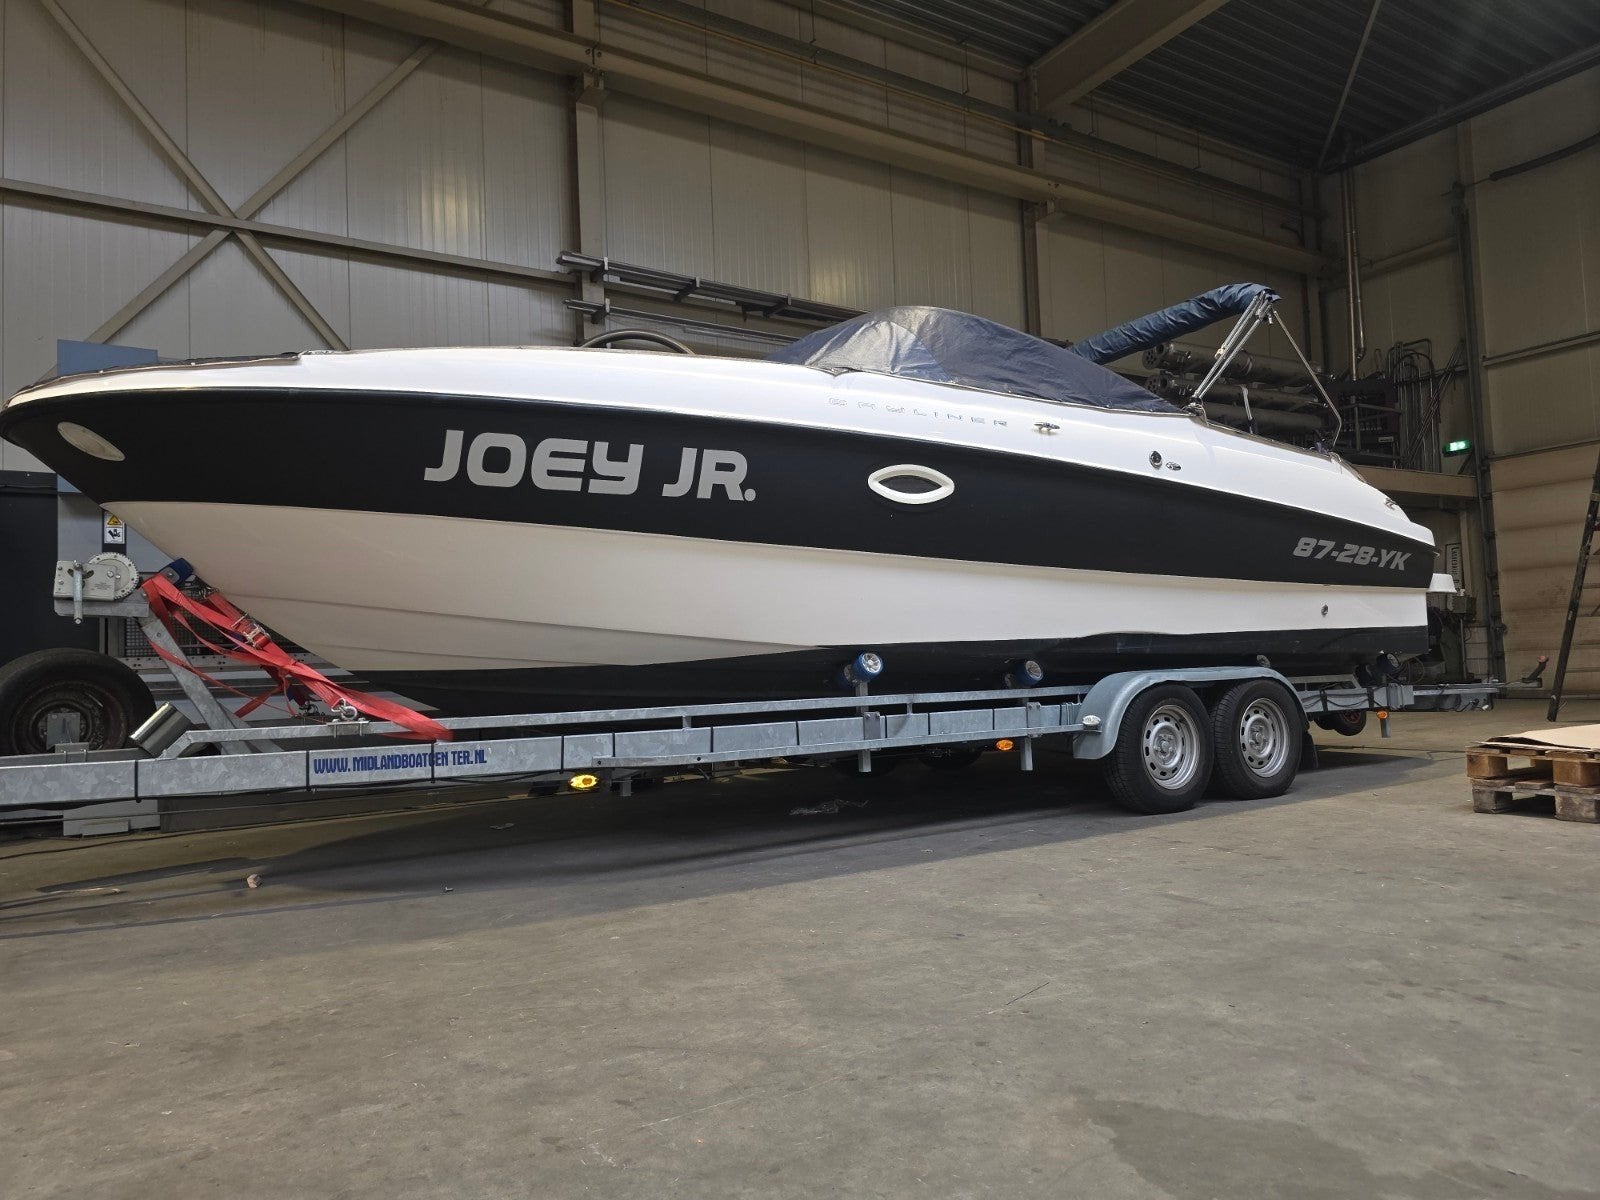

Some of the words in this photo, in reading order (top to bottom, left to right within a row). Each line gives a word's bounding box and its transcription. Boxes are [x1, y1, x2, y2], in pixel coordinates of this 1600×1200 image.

[424, 429, 644, 495] JOEY
[661, 447, 757, 501] JR.
[1292, 536, 1412, 571] 87-28-YK
